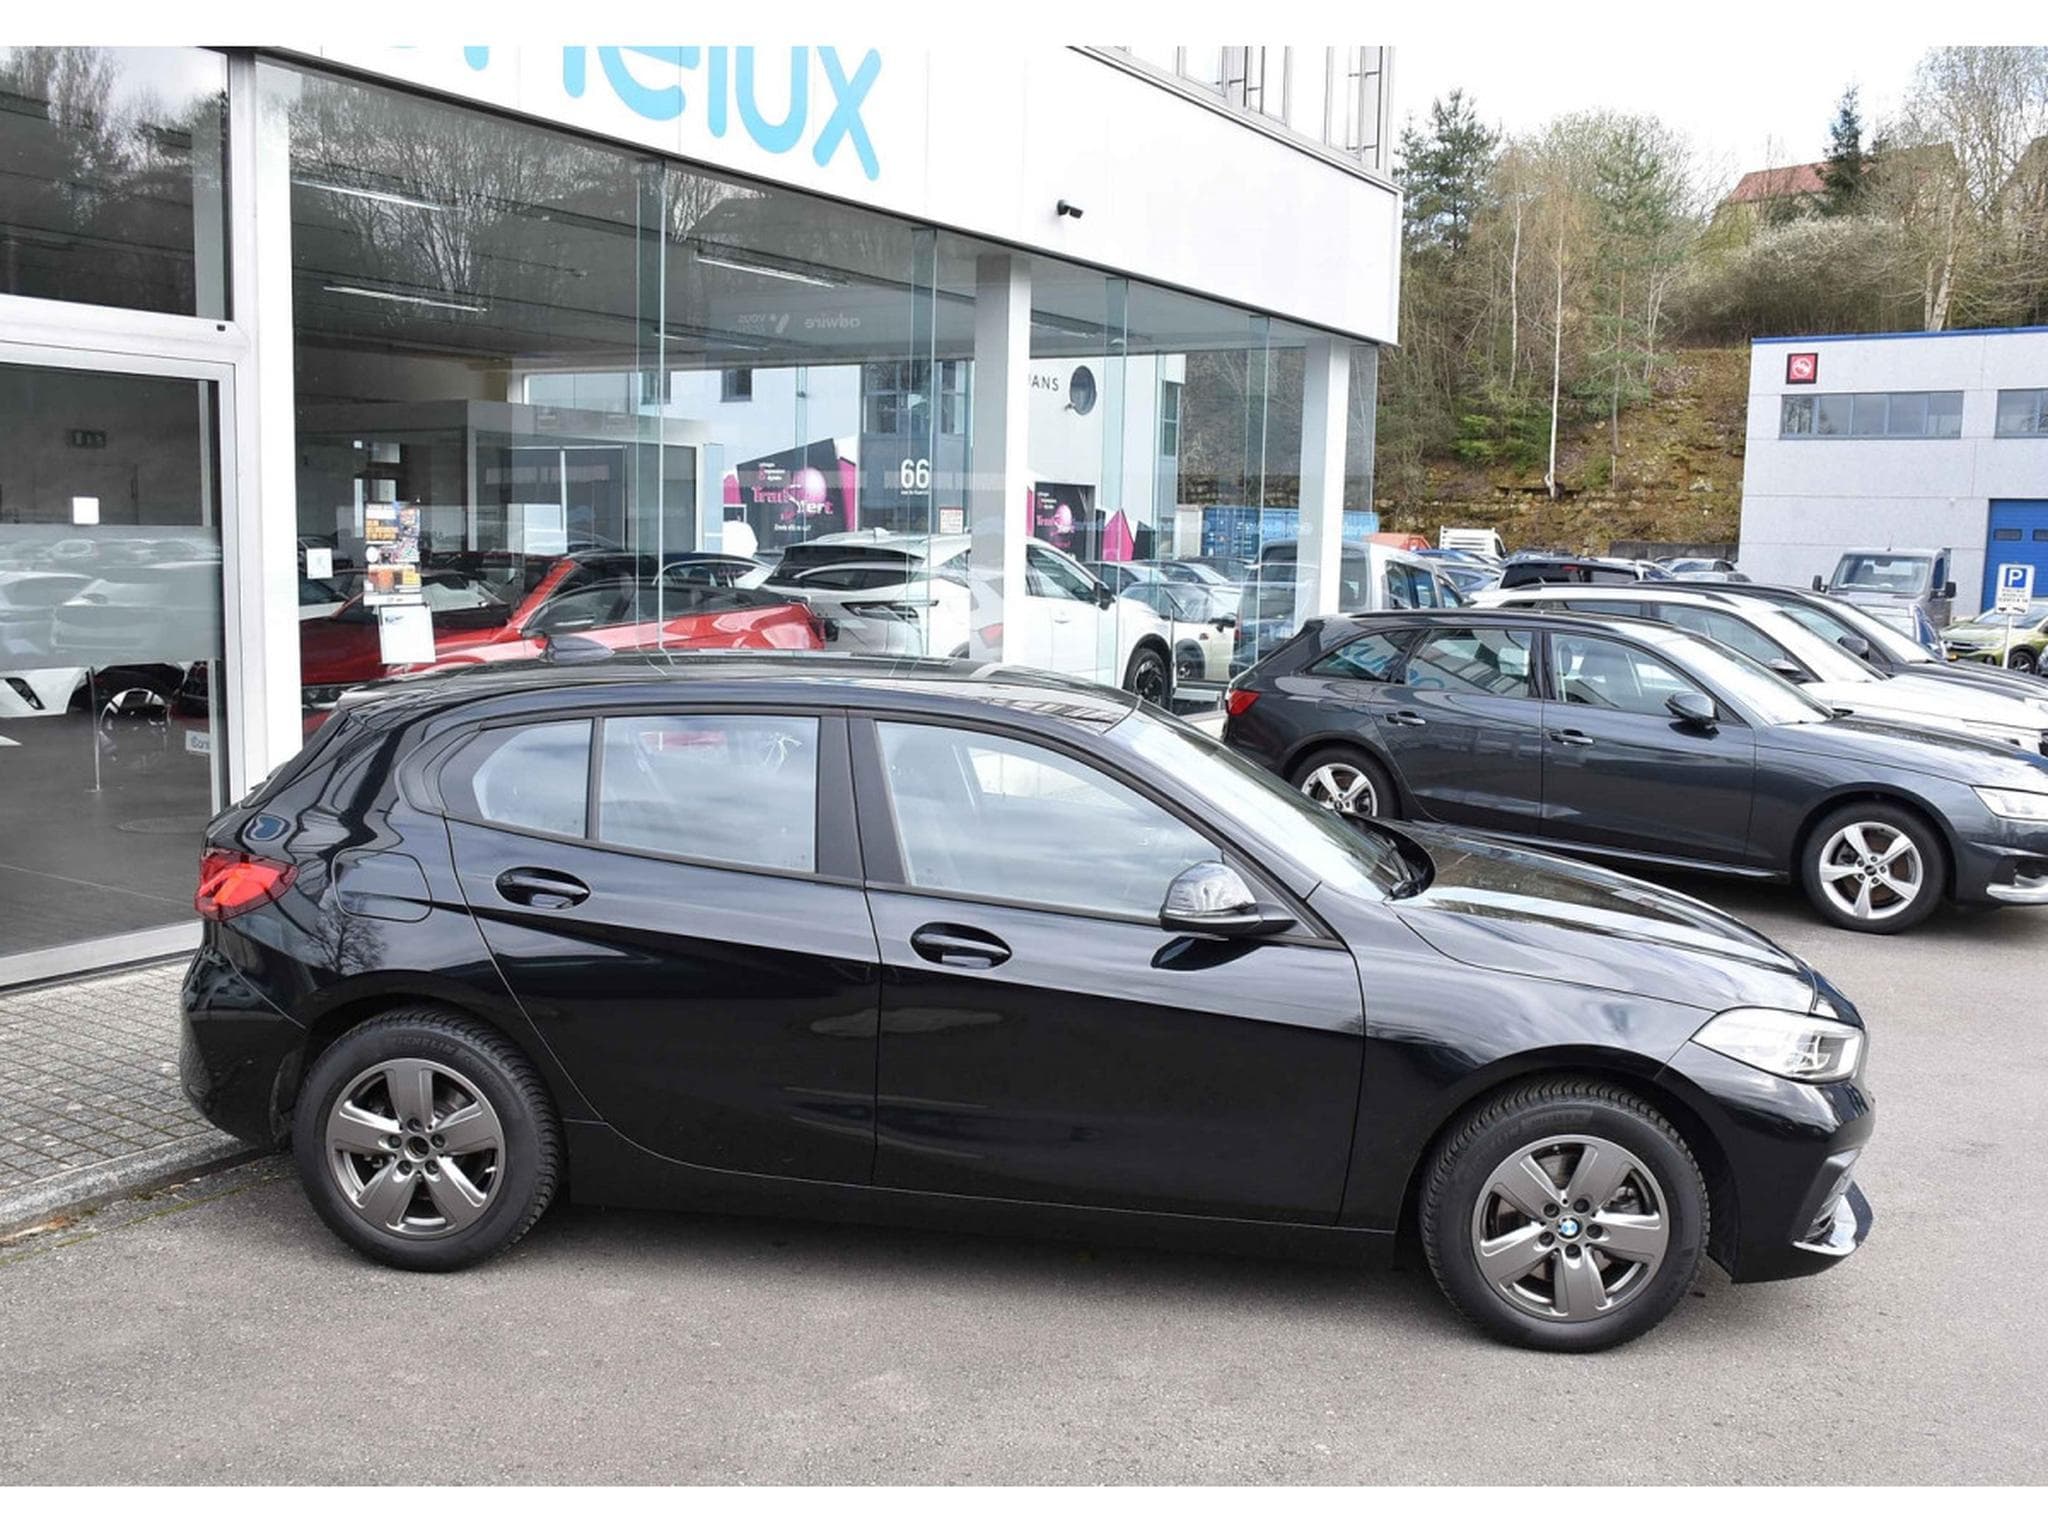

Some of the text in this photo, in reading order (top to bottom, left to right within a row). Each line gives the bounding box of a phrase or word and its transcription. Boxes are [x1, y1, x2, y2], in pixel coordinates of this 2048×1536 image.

[390, 46, 882, 181] elux
[901, 458, 930, 489] 66
[2008, 569, 2023, 587] P
